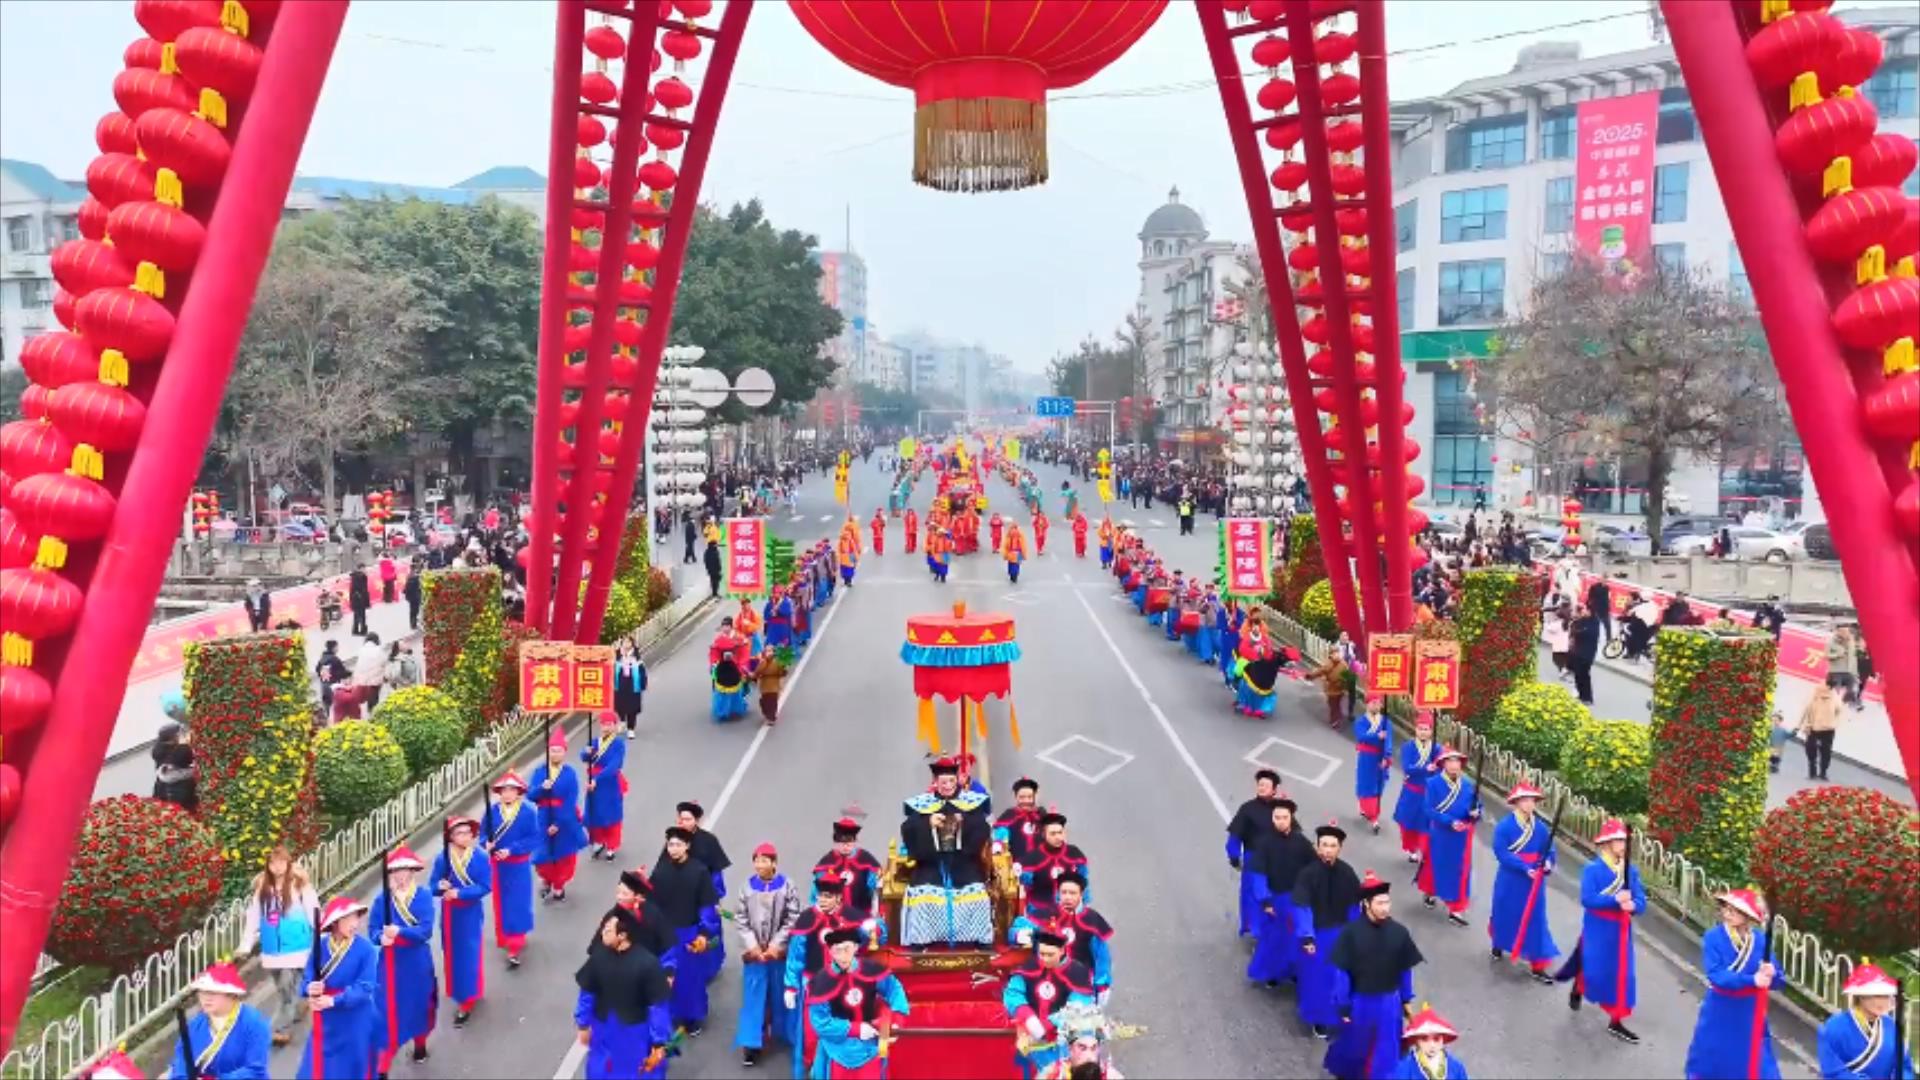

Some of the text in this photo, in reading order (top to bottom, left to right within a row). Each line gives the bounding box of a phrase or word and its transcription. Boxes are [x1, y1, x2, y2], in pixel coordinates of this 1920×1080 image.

[1580, 200, 1645, 220] 新春快乐
[577, 666, 604, 706] 回避
[1376, 653, 1402, 689] 回避
